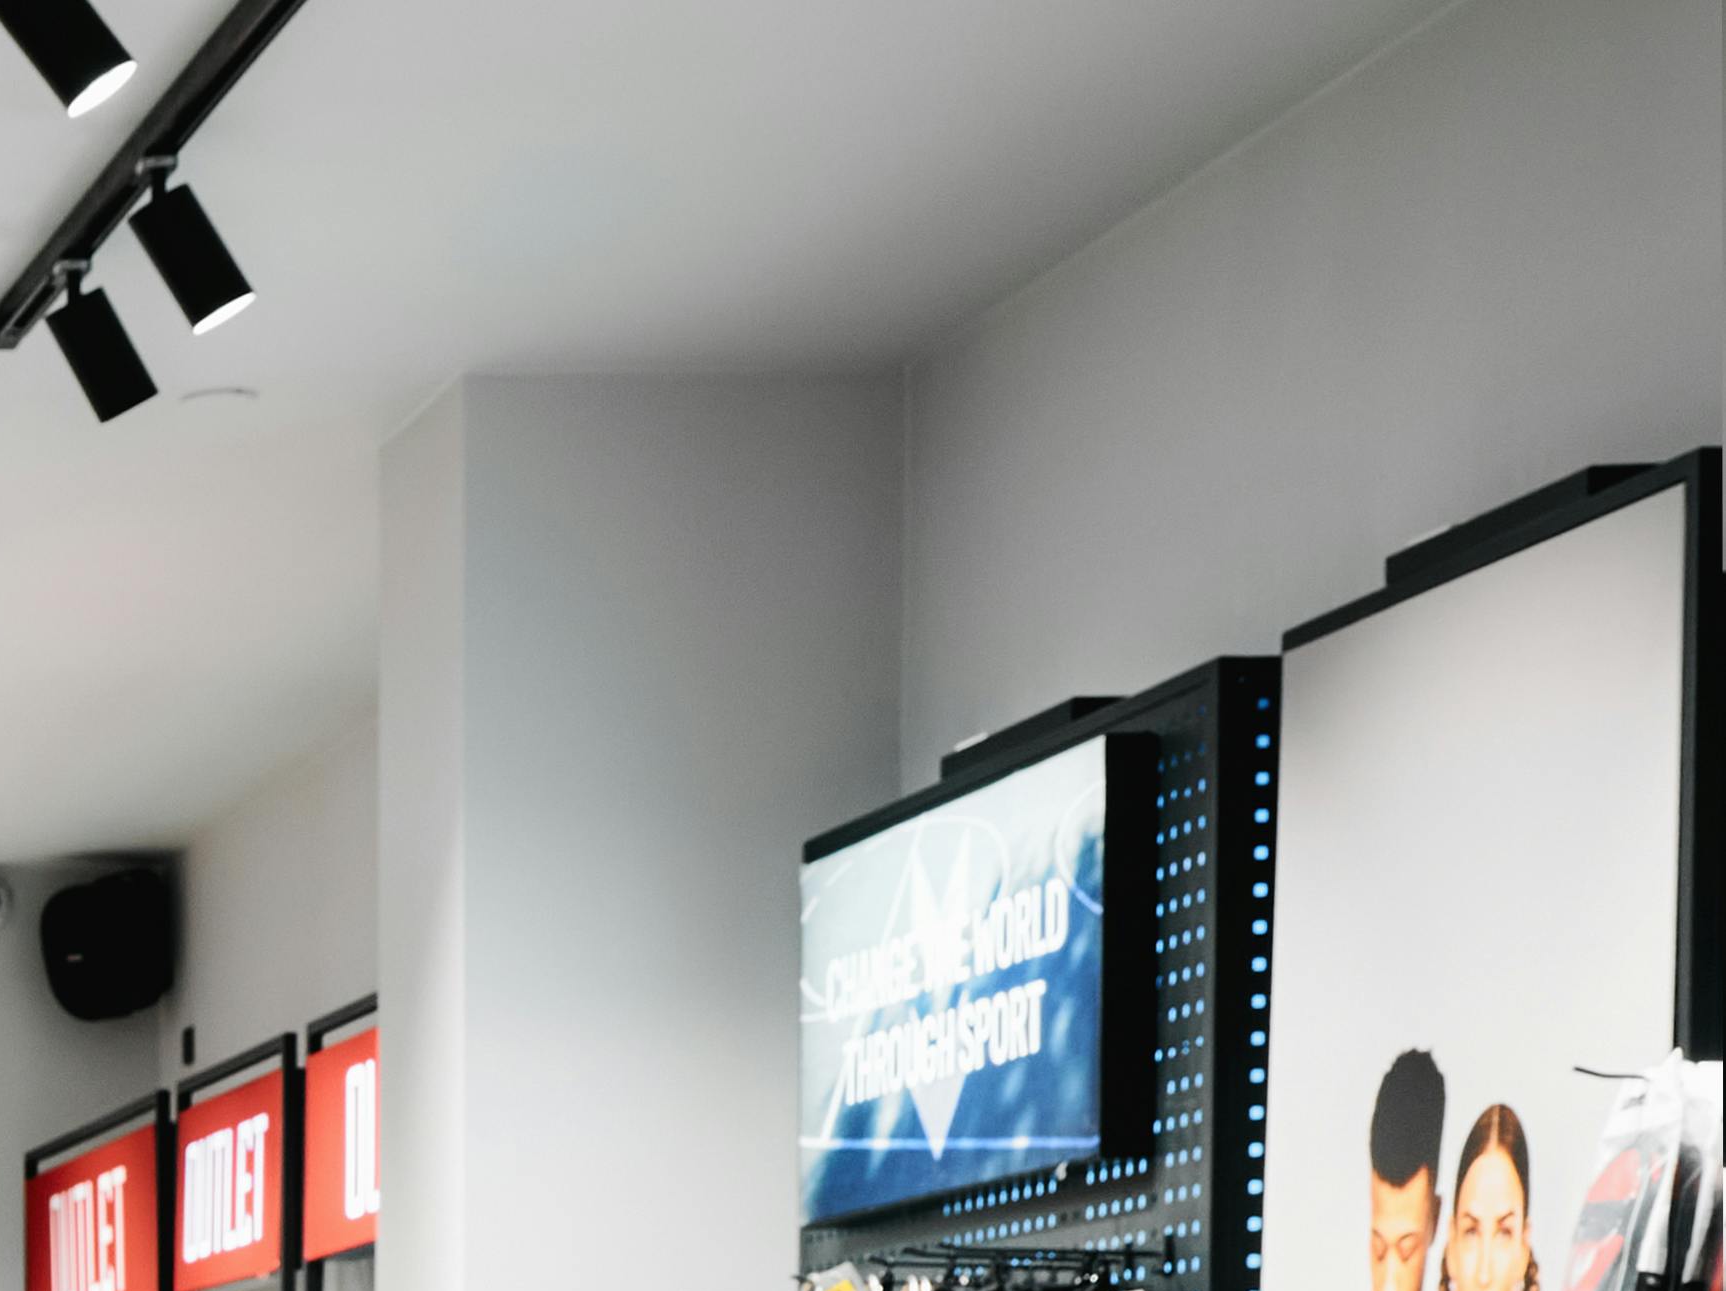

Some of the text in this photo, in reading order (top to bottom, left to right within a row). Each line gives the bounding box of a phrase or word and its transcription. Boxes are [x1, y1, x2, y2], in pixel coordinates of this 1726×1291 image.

[971, 878, 1069, 976] WORLD
[843, 979, 1047, 1106] THROUGH SPORT
[182, 1112, 269, 1264] OUTLET
